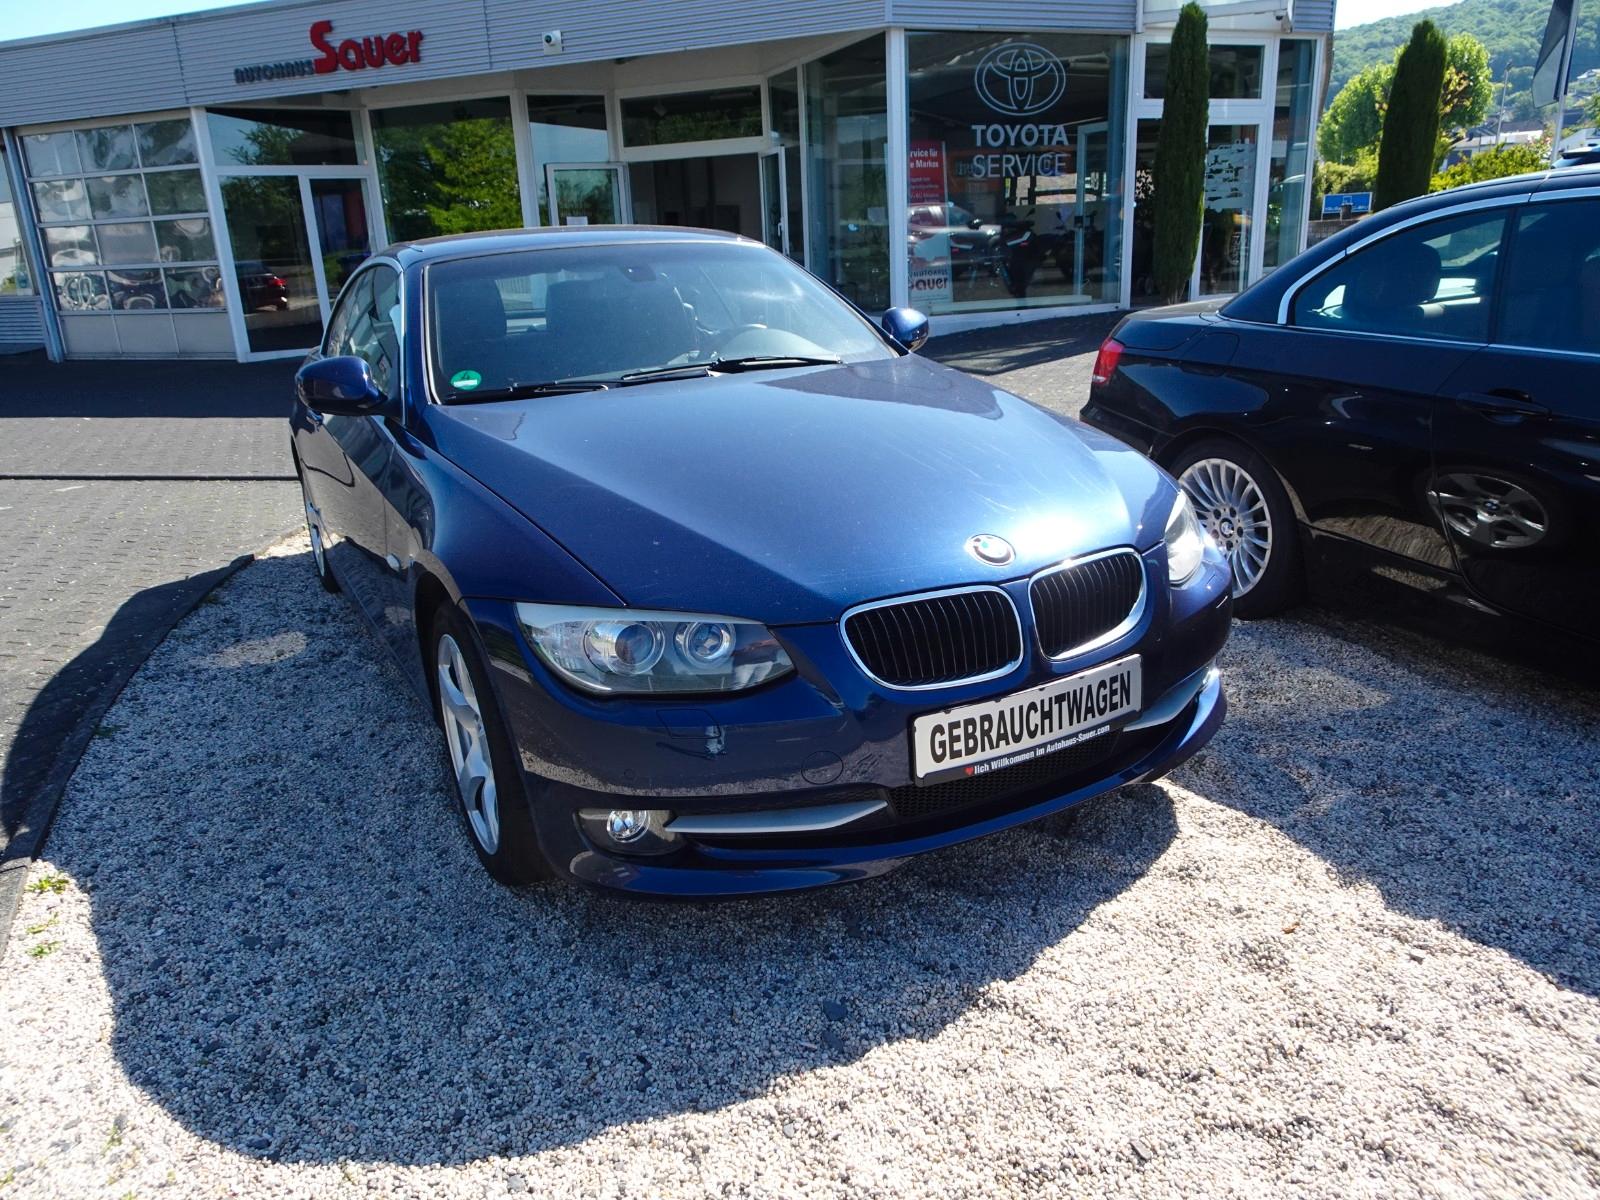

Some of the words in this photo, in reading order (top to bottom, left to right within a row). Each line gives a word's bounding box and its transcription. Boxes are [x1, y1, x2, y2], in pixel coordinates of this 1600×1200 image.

[309, 20, 424, 75] Sauer
[910, 148, 929, 157] rvice
[971, 123, 1069, 147] TOYOTA
[972, 154, 1067, 178] SERVICE
[929, 670, 1131, 764] GEBRAUCHTWAGEN
[990, 750, 1035, 770] Willkommen
[1036, 747, 1045, 756] im
[1046, 724, 1111, 753] Autohaus-Sauer.com
